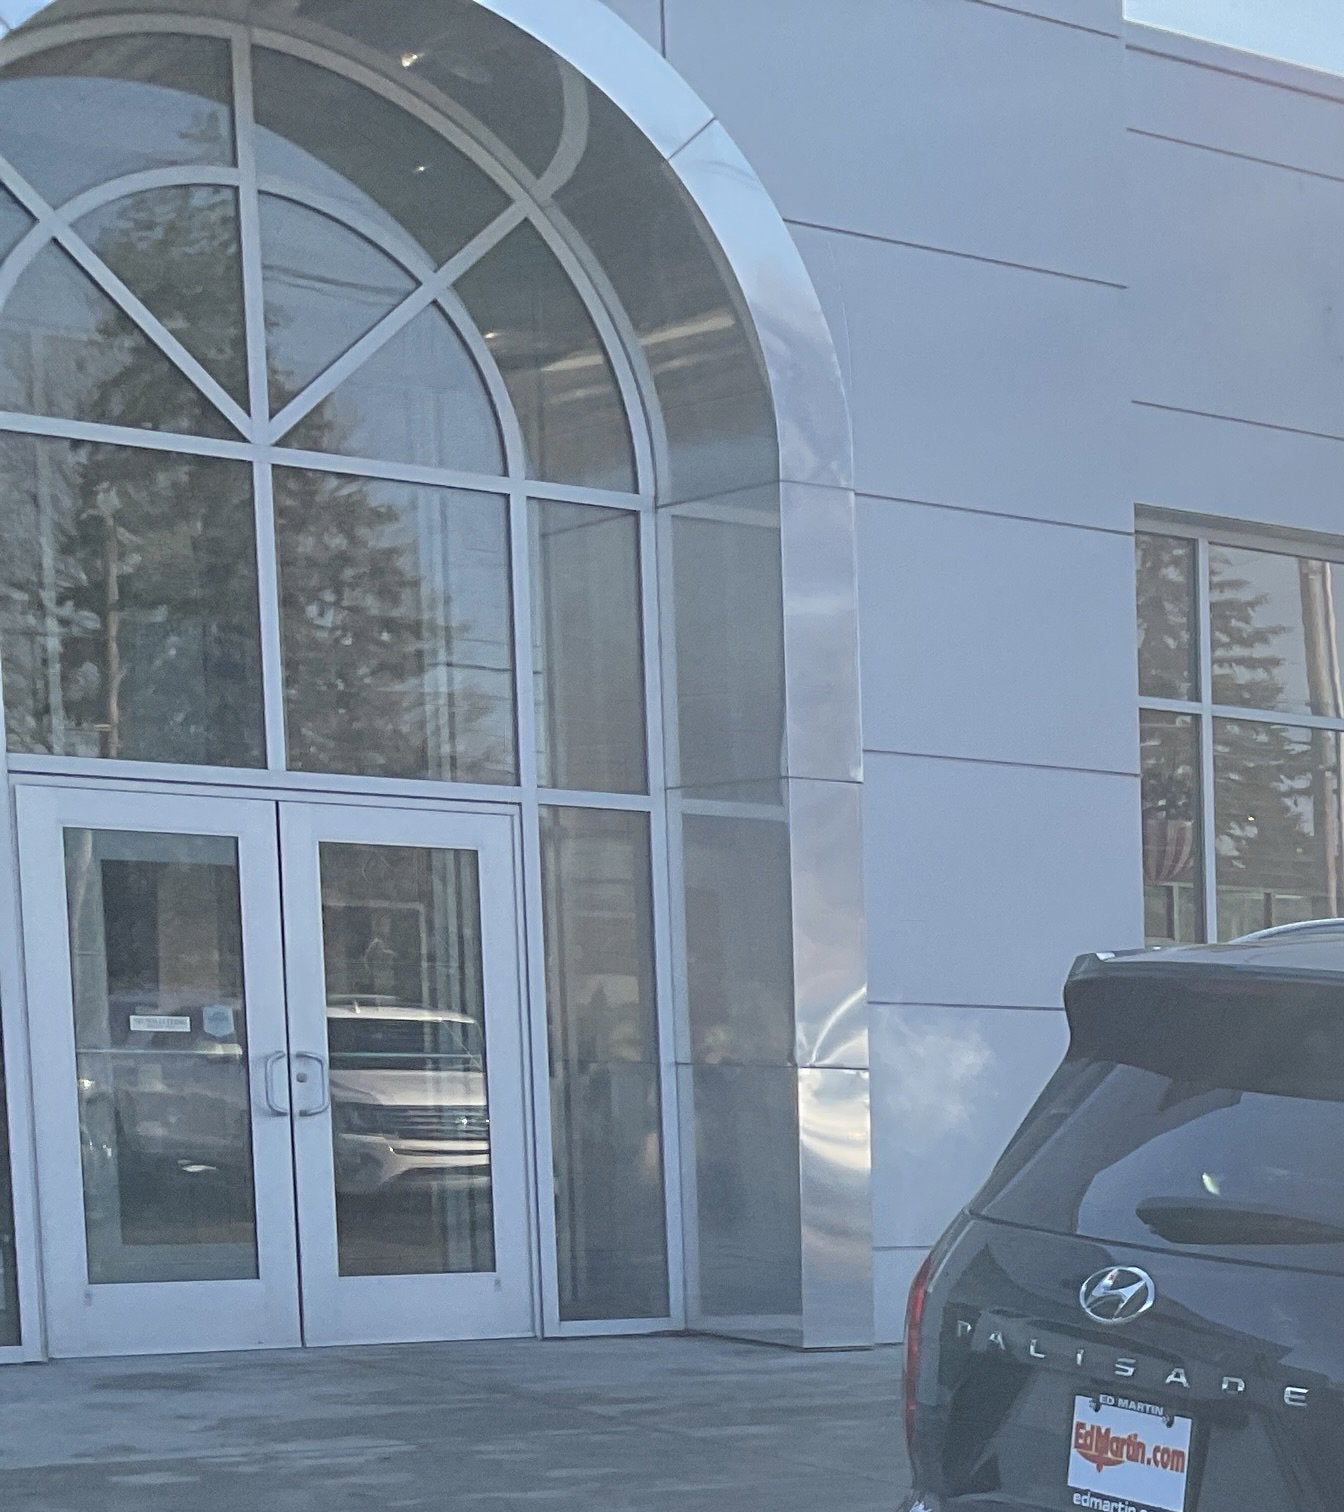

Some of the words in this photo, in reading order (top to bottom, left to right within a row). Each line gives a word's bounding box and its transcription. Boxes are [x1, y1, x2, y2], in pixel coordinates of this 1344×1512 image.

[957, 1320, 1312, 1407] PALISADE
[1100, 1394, 1115, 1405] ED
[1118, 1398, 1164, 1416] MARTIN
[1074, 1421, 1185, 1473] EdMartin.com
